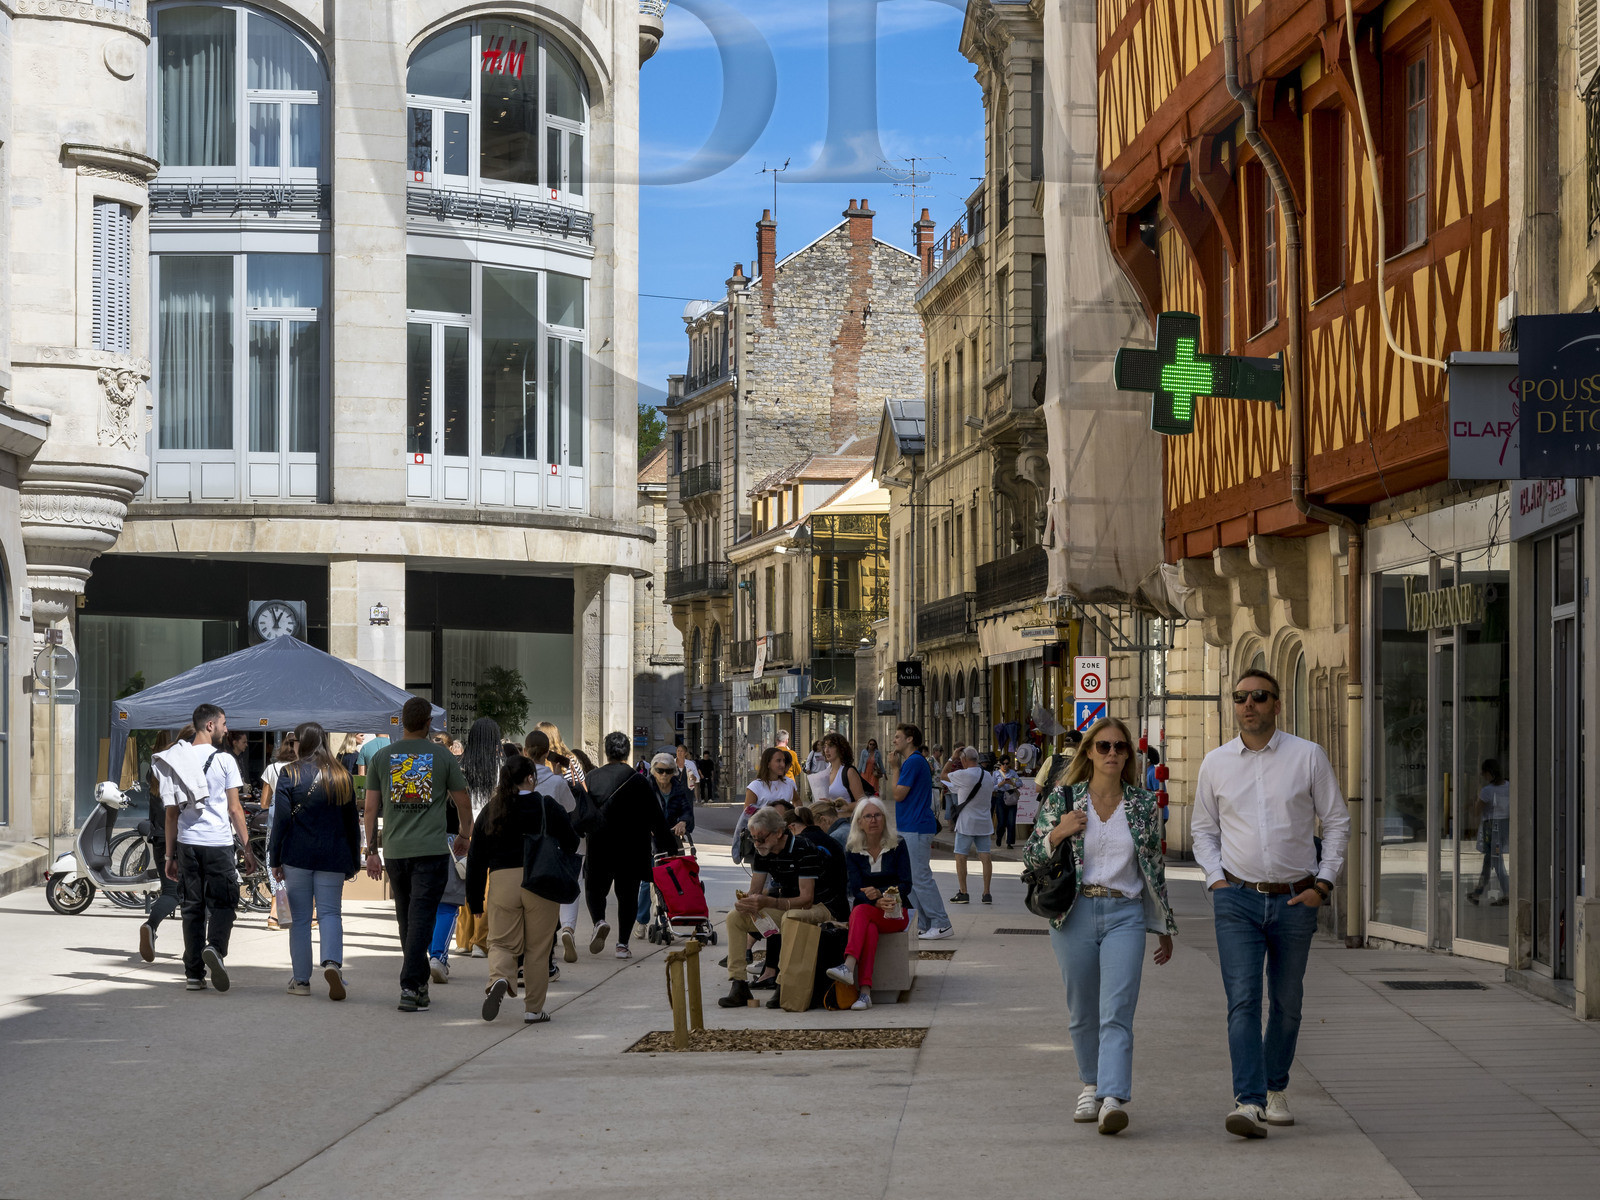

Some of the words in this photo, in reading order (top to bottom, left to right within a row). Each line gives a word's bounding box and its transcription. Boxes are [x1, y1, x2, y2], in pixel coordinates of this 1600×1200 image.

[481, 35, 528, 81] H&M
[450, 678, 477, 687] Femme
[1084, 678, 1097, 687] 30
[450, 690, 478, 699] Homme
[450, 702, 478, 711] Divided
[450, 714, 469, 723] Bébé
